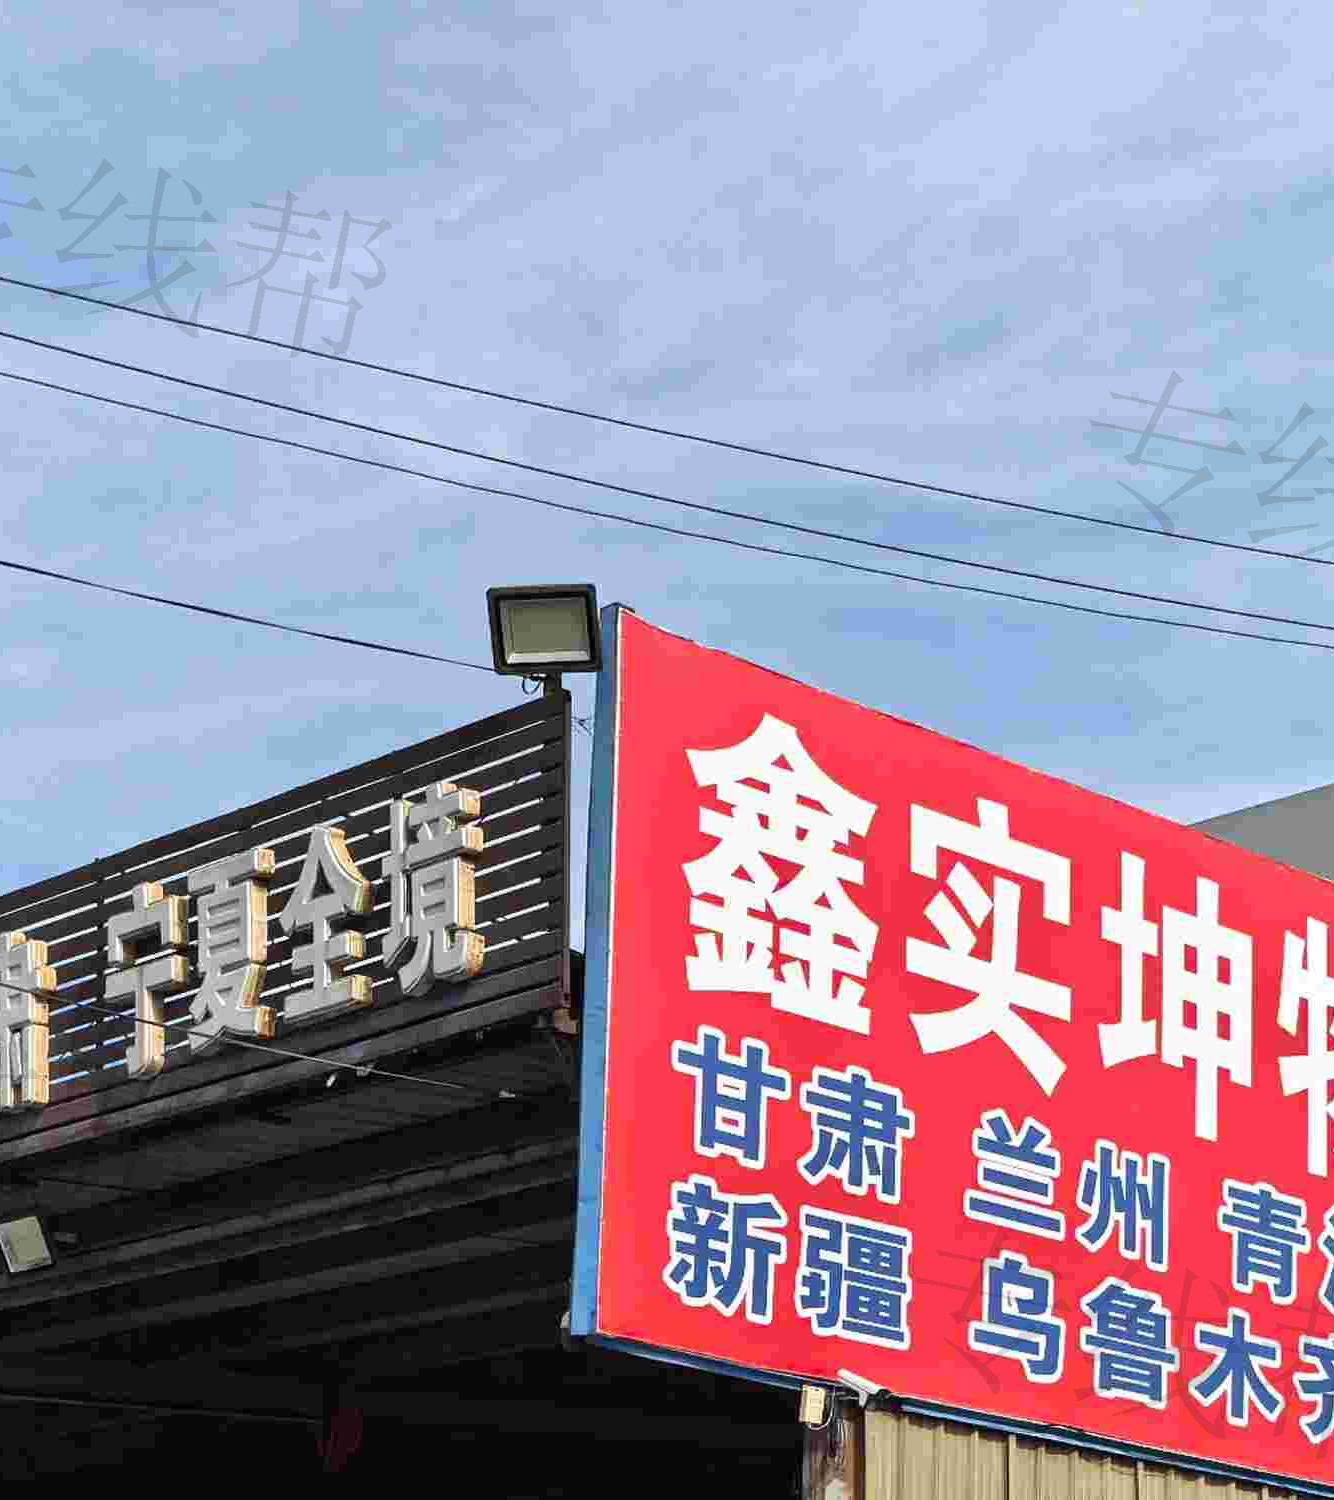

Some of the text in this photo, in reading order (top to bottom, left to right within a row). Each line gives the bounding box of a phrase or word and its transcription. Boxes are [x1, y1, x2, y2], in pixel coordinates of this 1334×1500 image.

[104, 780, 485, 1079] 宁夏全境
[662, 1173, 916, 1350] 新疆
[671, 1024, 916, 1206] 甘肃
[963, 1108, 1171, 1274] 兰州
